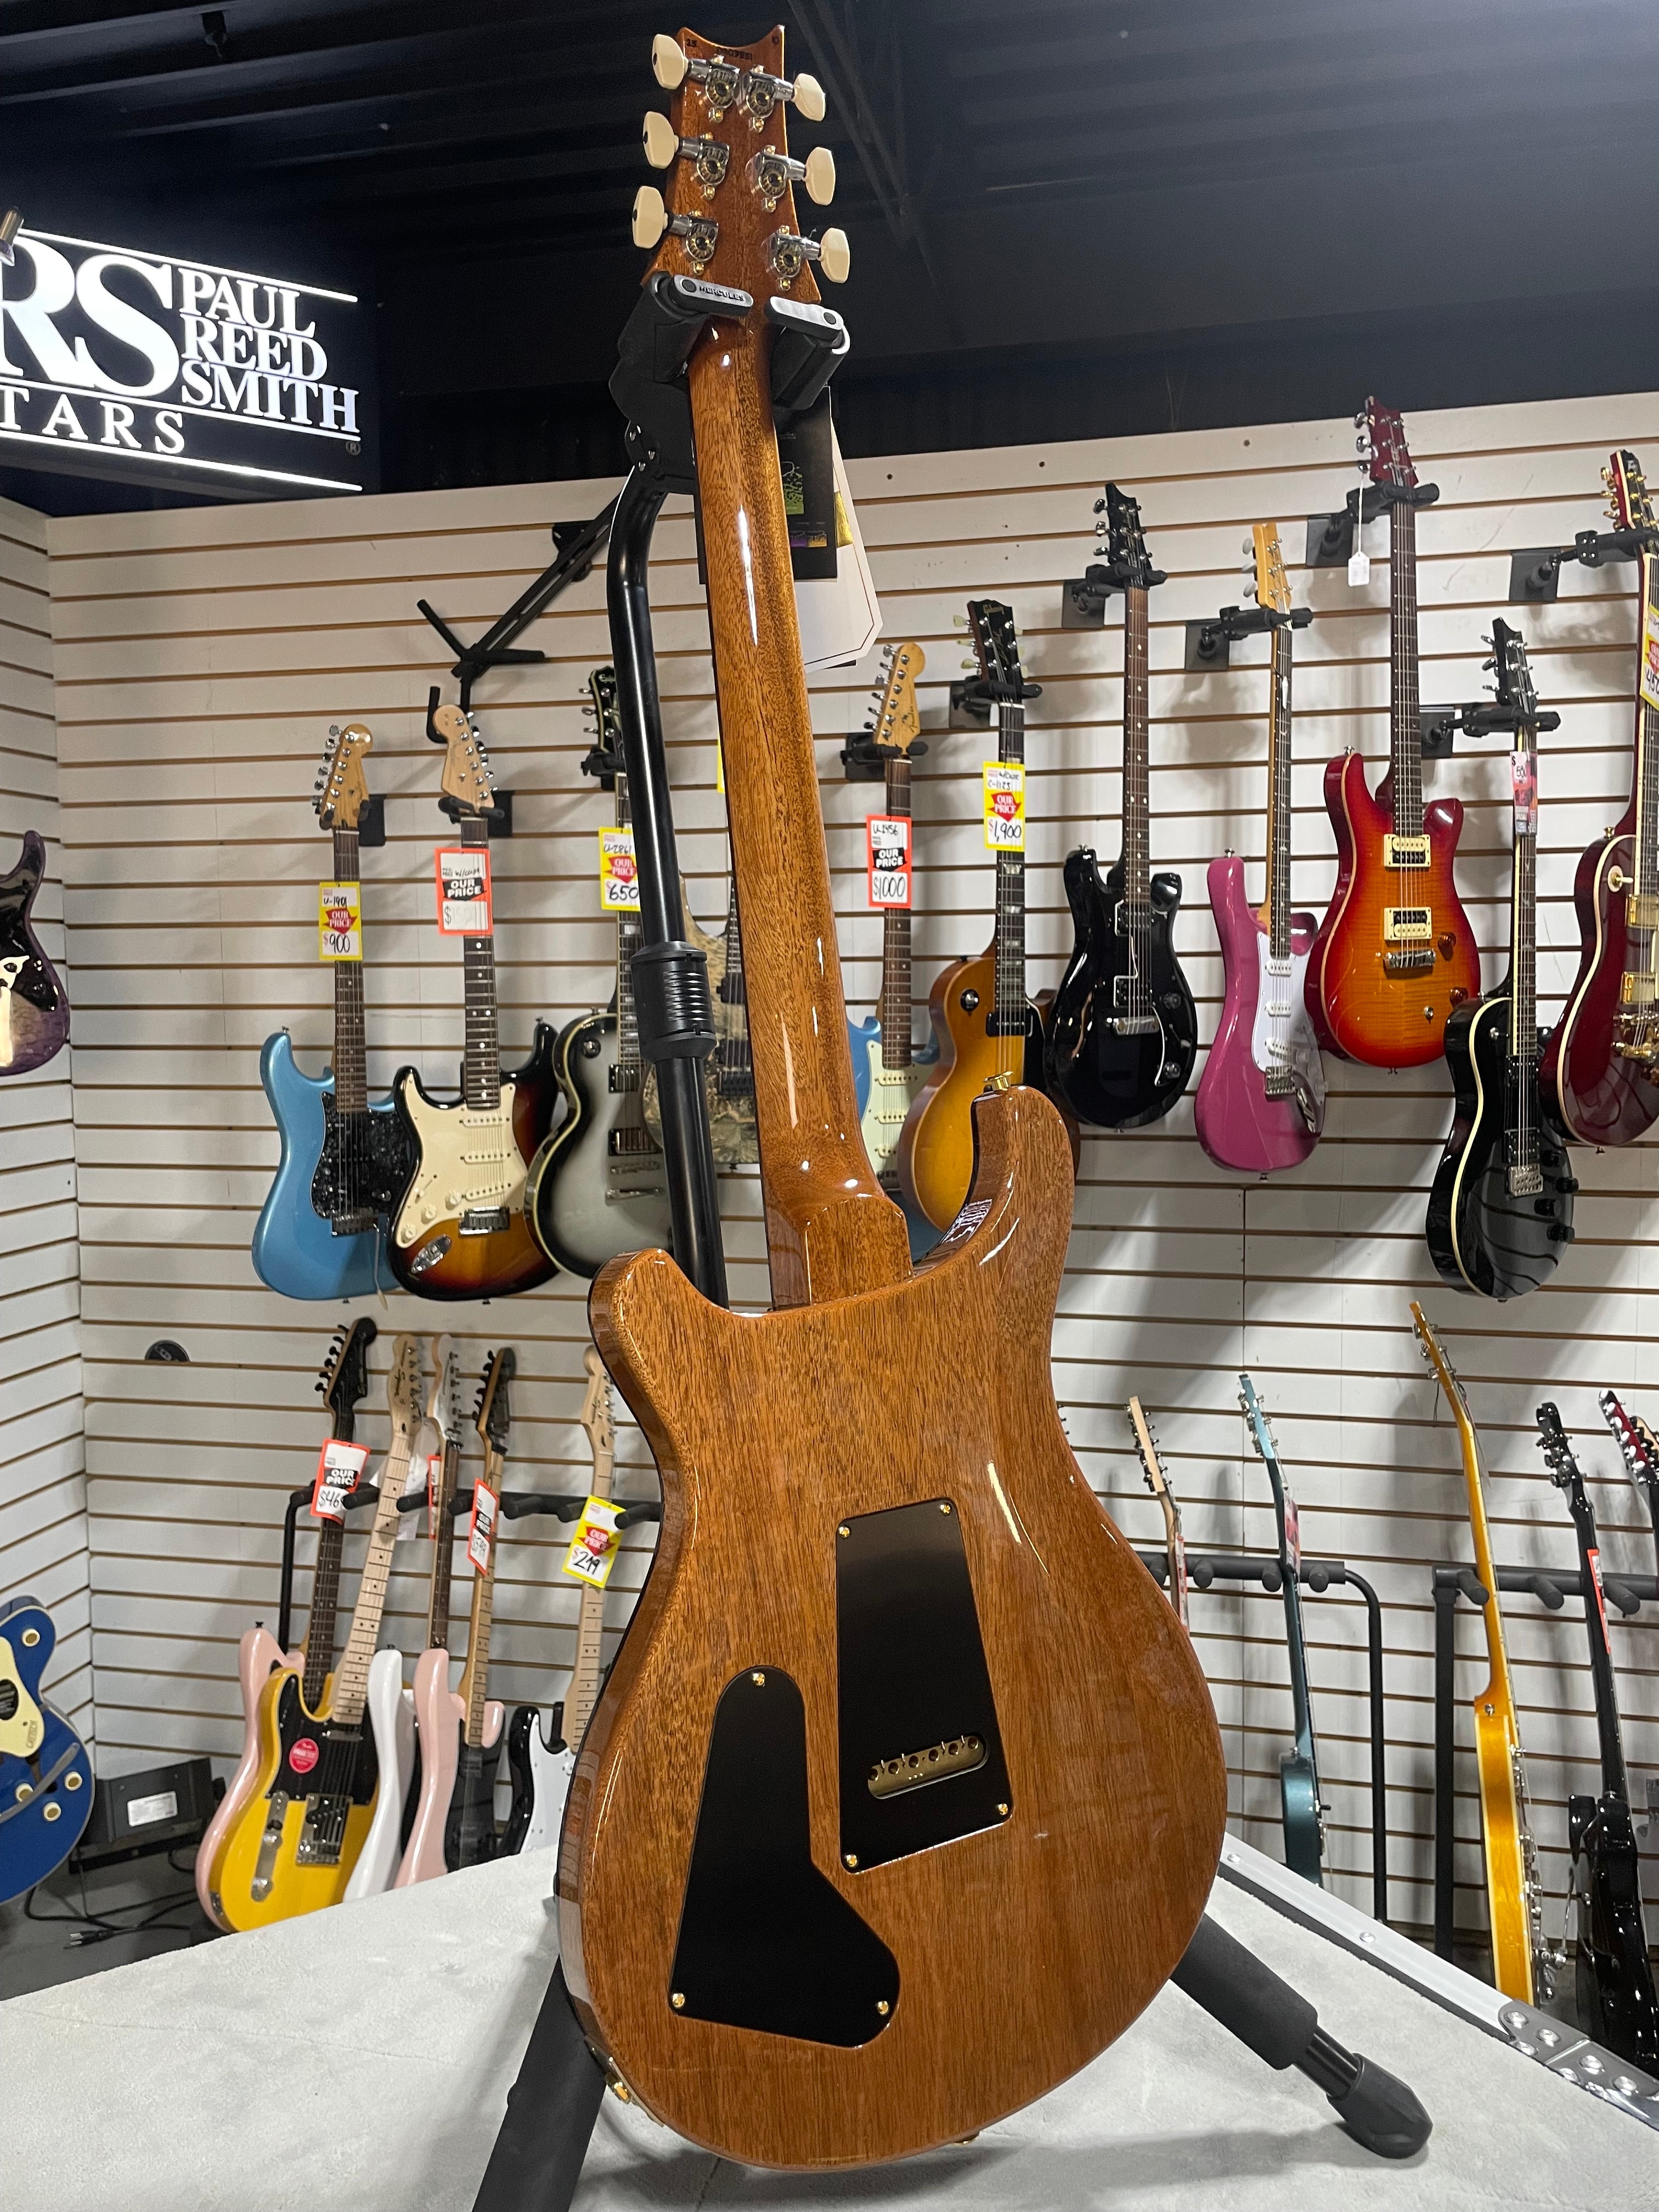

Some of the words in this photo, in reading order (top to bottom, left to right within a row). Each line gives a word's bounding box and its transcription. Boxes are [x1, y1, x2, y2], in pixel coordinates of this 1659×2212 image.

[178, 268, 316, 337] PAUL
[179, 313, 328, 381] REED
[182, 359, 360, 433] SMITH
[0, 386, 185, 454] TARS
[996, 794, 1014, 805] OUR
[994, 803, 1017, 814] PRICE
[879, 849, 899, 859] OUR
[614, 858, 633, 867] OUR
[876, 856, 904, 868] PRICE
[612, 866, 635, 876] PRICE
[450, 879, 475, 889] OUR
[873, 877, 906, 900] $1000
[447, 885, 482, 899] PRICE
[331, 911, 349, 919] OUR
[329, 919, 351, 928] PRICE
[331, 1468, 354, 1479] OUR
[589, 1528, 609, 1543] OUR
[584, 1536, 609, 1551] PRICE
